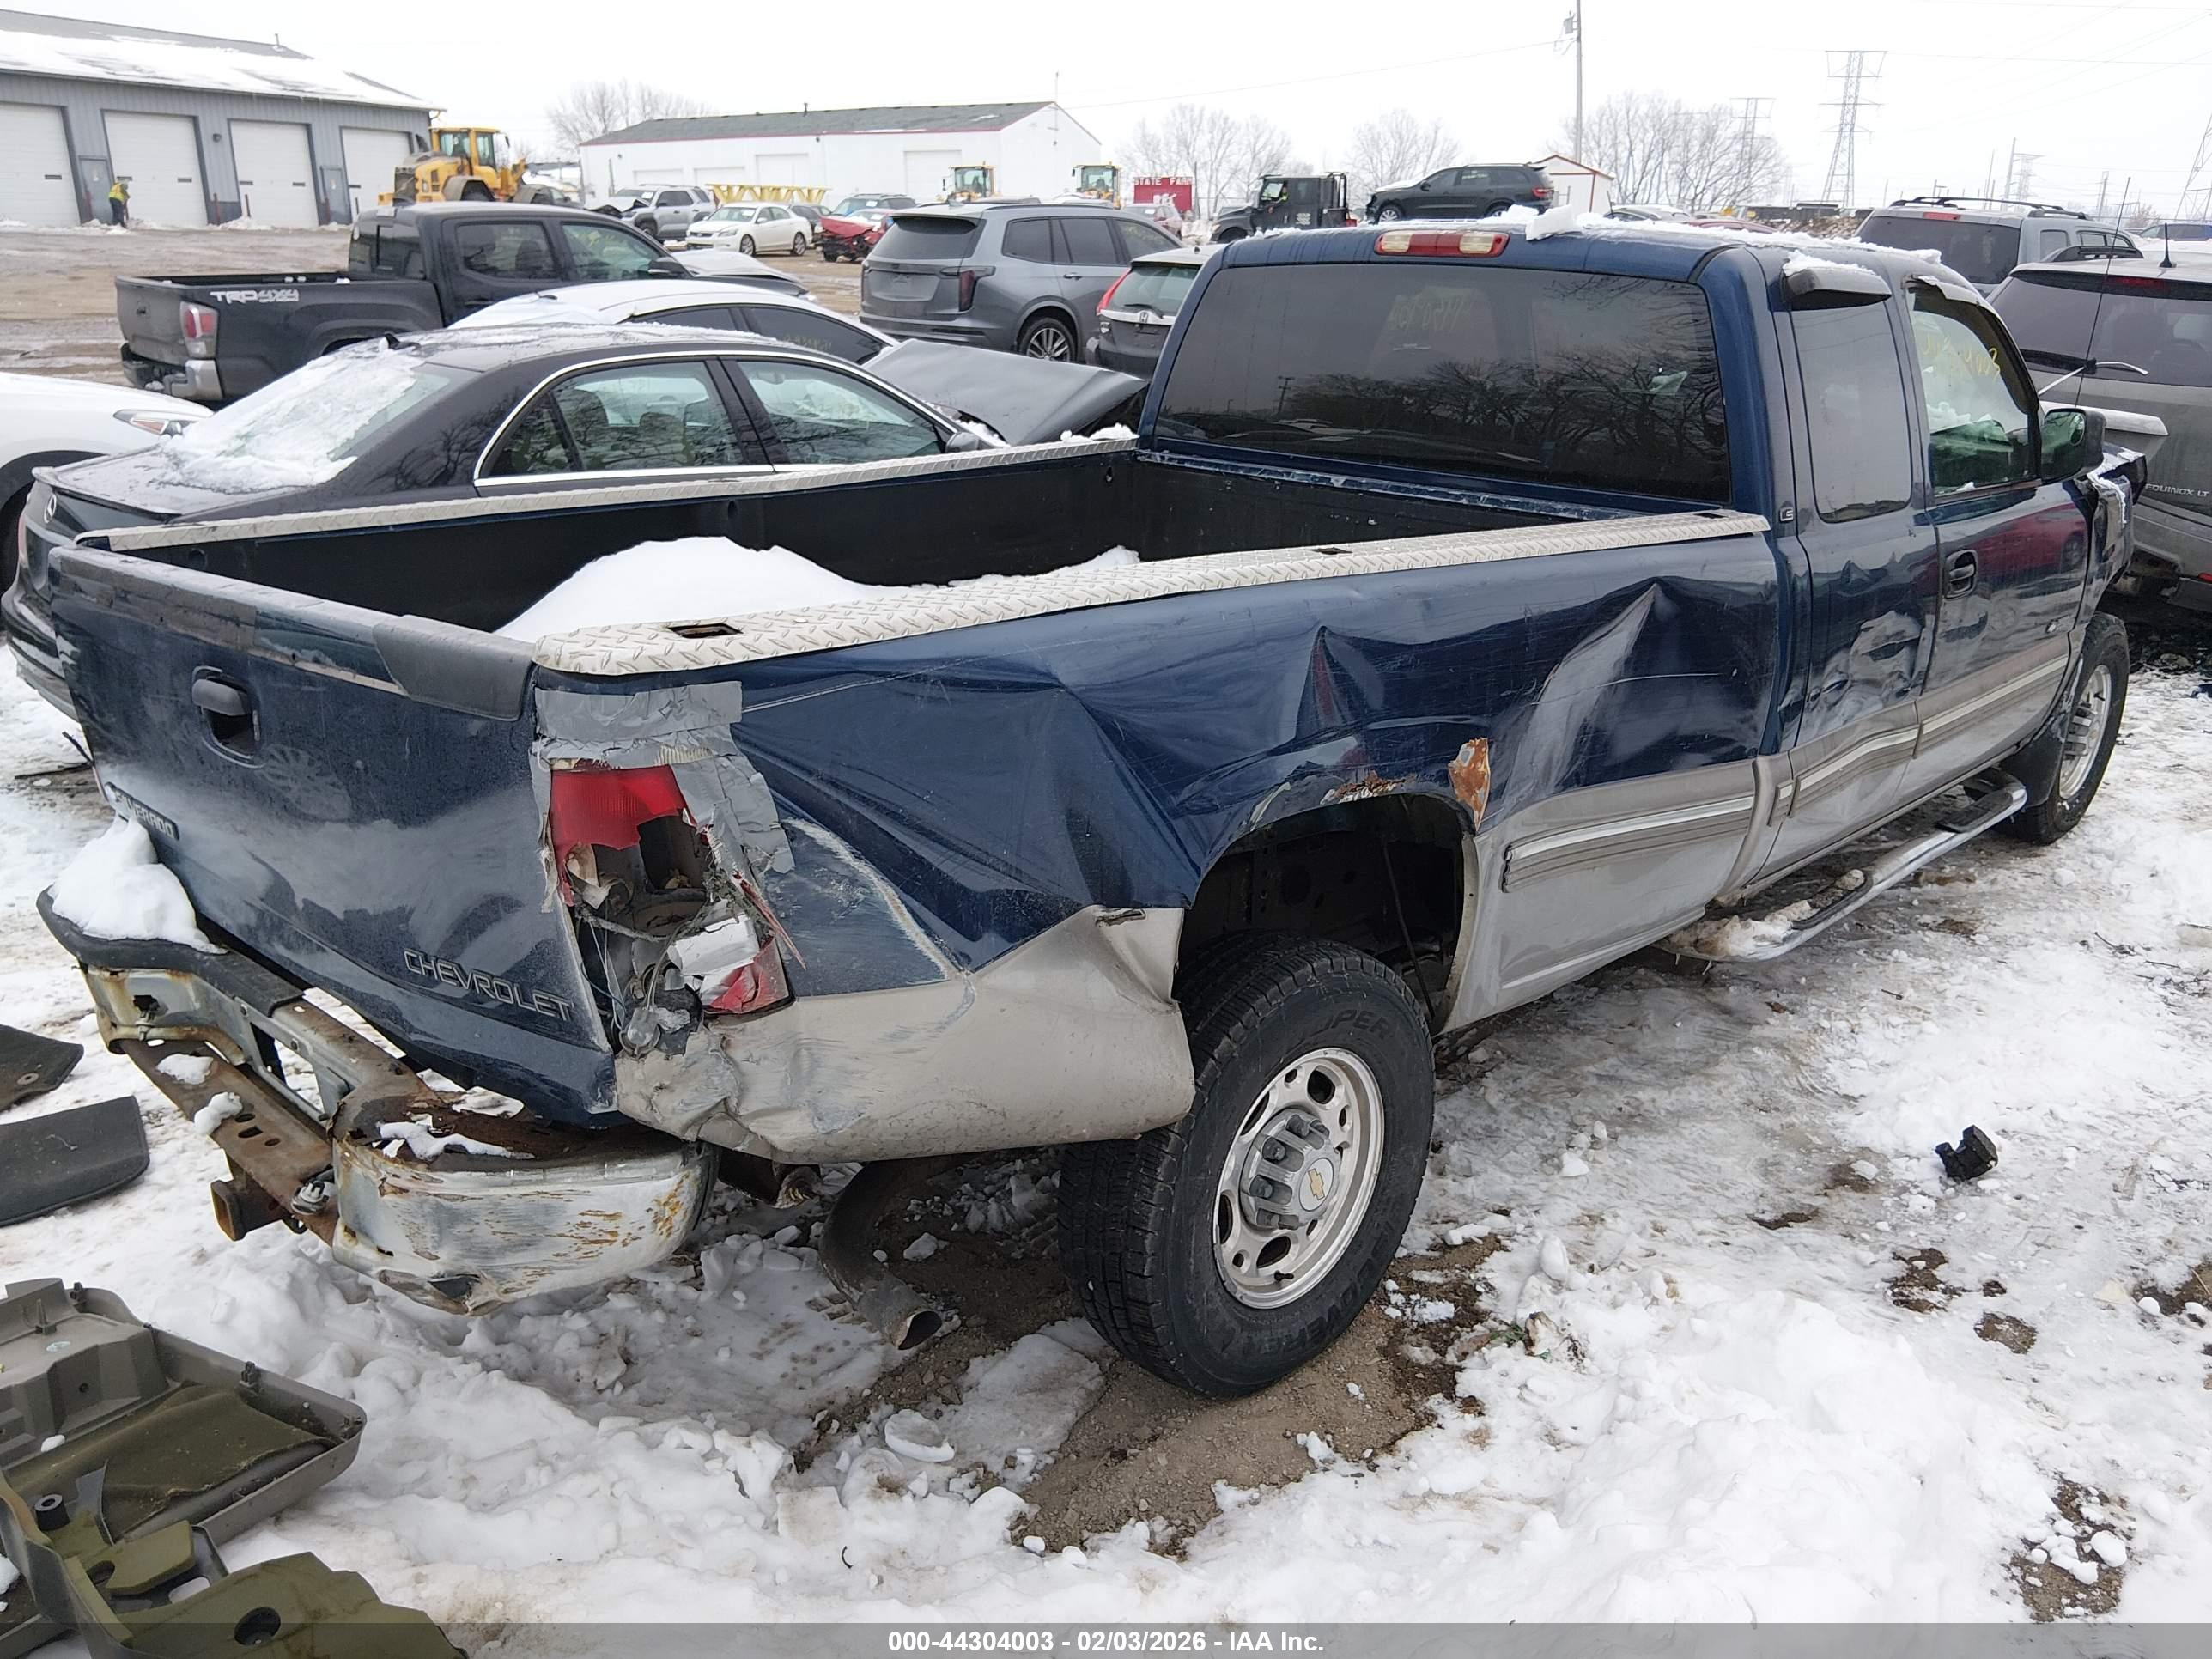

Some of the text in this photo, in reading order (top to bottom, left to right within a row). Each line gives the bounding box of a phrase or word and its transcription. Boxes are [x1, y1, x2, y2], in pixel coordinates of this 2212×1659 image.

[1133, 177, 1162, 186] STATE
[209, 290, 258, 304] TRD
[2145, 483, 2195, 495] EQUINOX
[404, 948, 574, 1022] CHEVROLET
